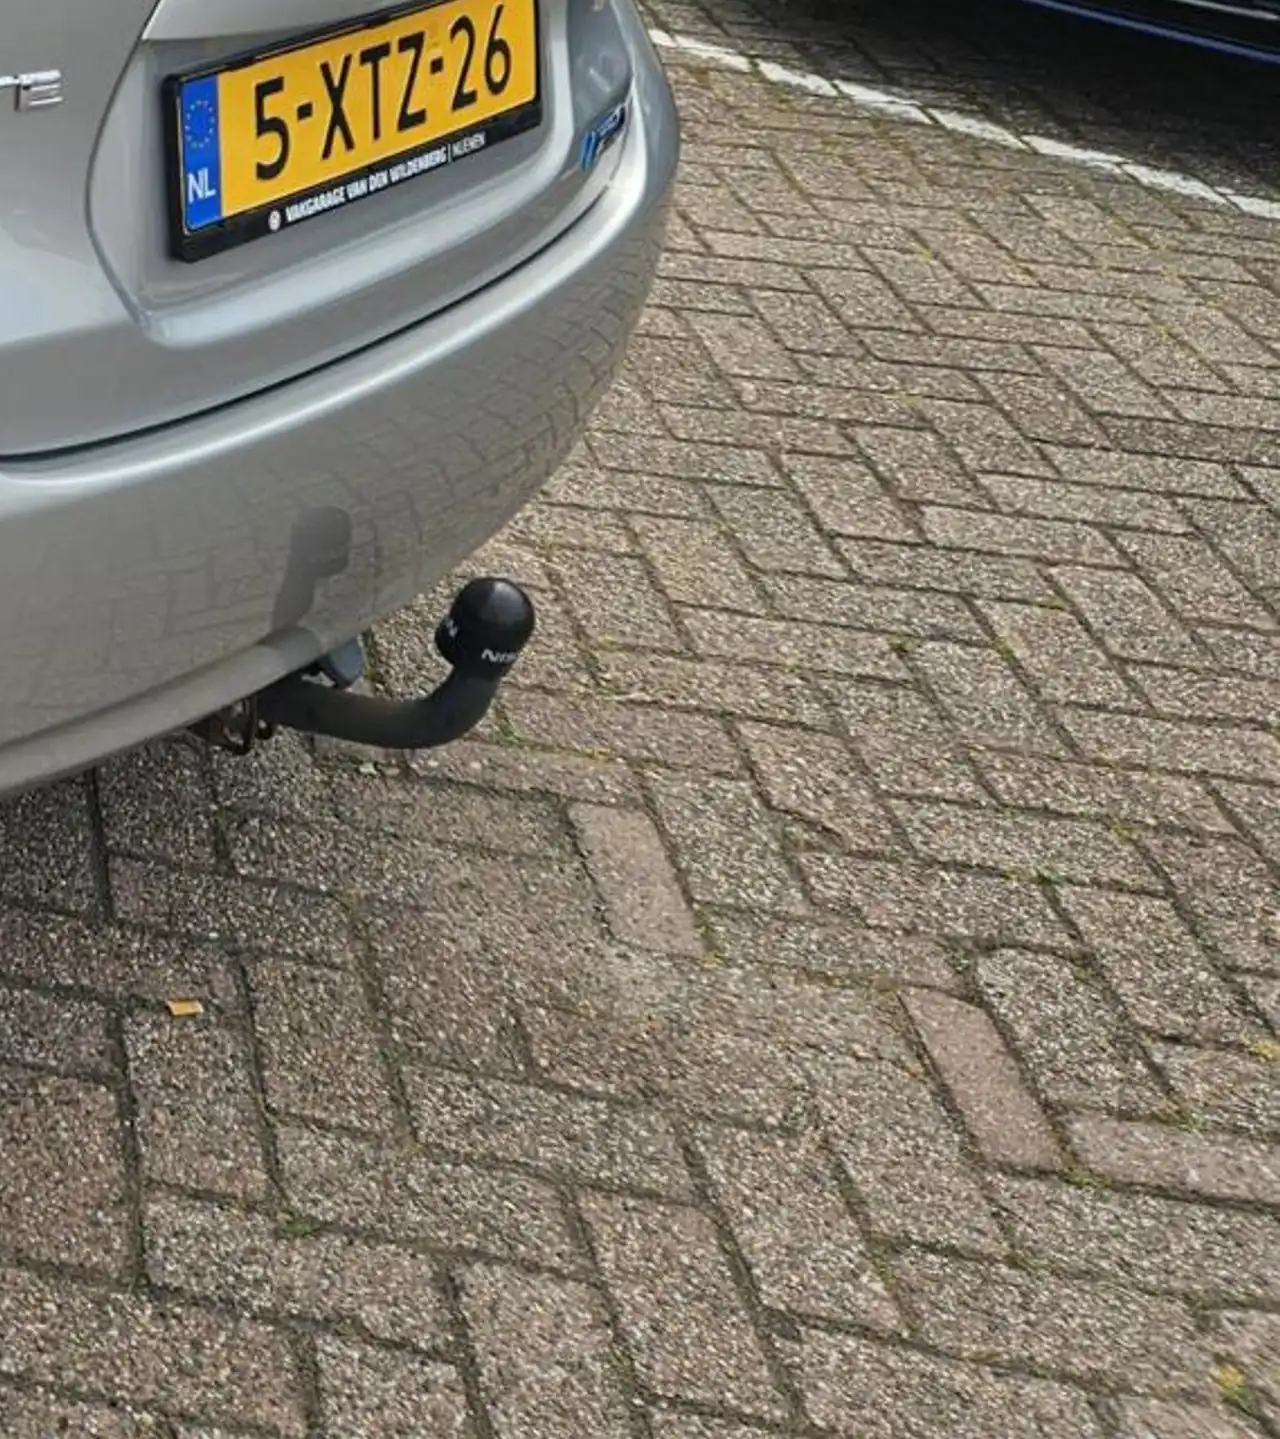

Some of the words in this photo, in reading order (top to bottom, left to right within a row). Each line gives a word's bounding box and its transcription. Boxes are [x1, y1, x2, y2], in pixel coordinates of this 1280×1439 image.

[254, 4, 512, 181] 5-XTZ-26
[187, 169, 216, 203] NL
[347, 178, 368, 200] VAN
[369, 170, 389, 192] DEN
